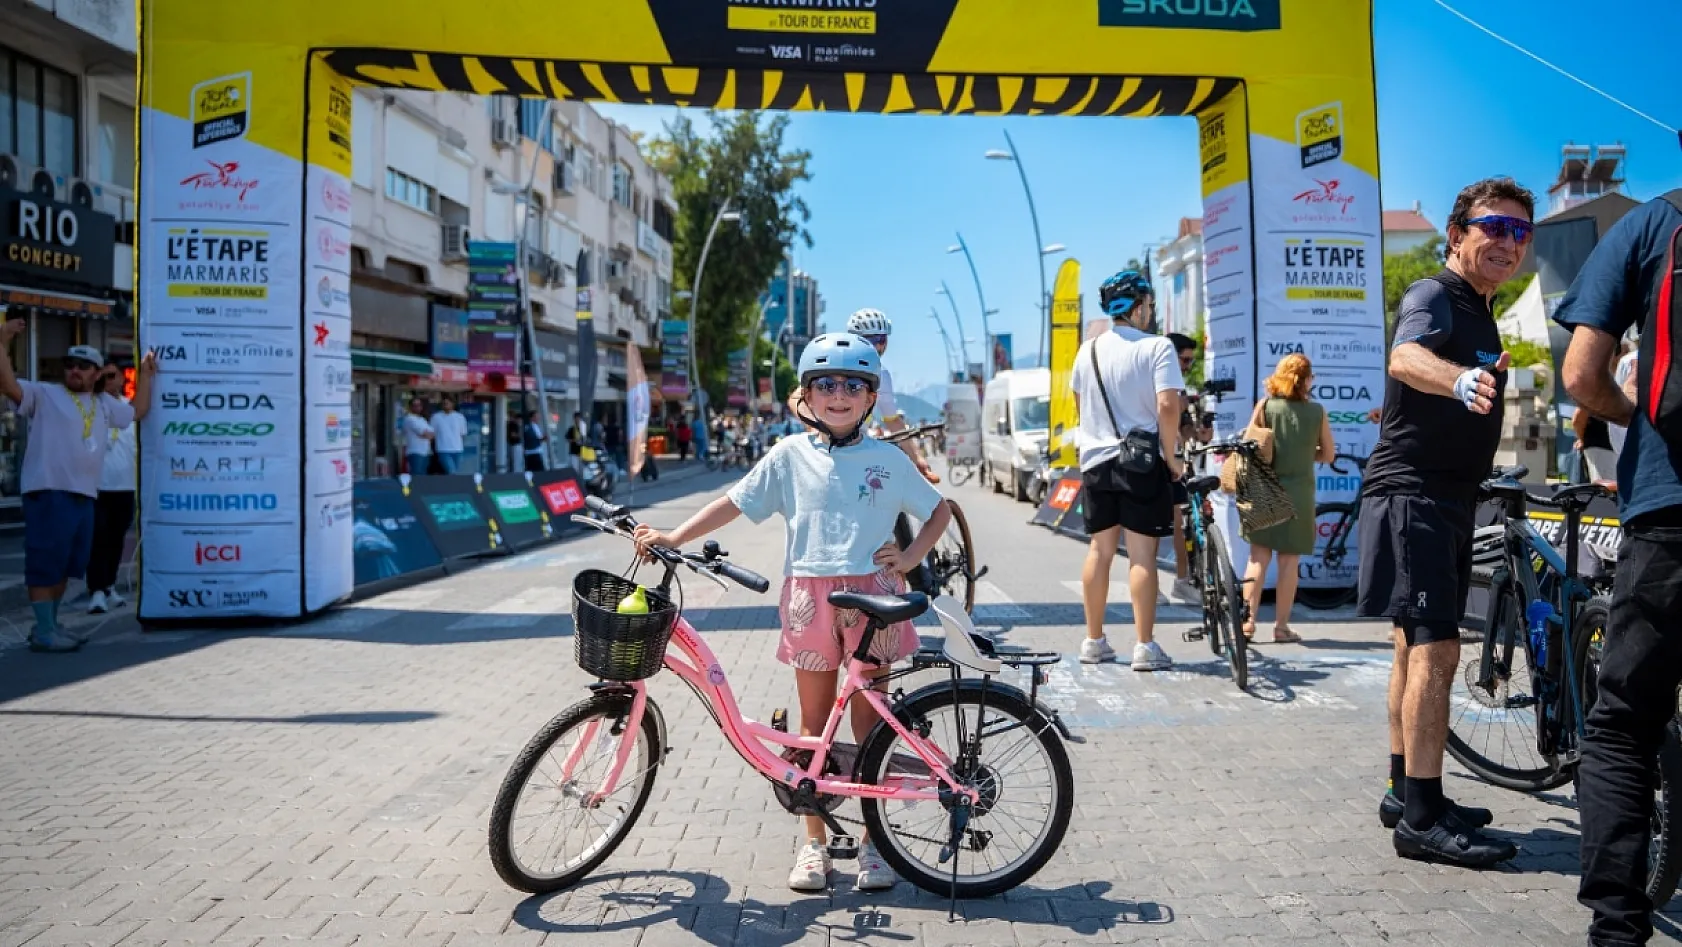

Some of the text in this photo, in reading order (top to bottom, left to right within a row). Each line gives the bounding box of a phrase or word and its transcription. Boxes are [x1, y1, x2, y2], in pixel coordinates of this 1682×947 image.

[778, 14, 809, 27] TOUR
[811, 16, 825, 28] DE
[828, 16, 870, 30] FRANCE
[771, 44, 802, 59] VISA
[19, 199, 78, 247] RIO
[9, 243, 82, 272] CONCEPT
[200, 287, 264, 298] TOUR DE FRANCE
[1314, 290, 1331, 298] TOUR
[1342, 290, 1364, 299] FRANCE
[195, 306, 216, 315] VISA
[150, 343, 294, 360] VISA maximiles
[1268, 342, 1304, 355] VISA
[1308, 385, 1371, 400] KODA
[163, 421, 275, 437] MOSSO
[170, 457, 265, 472] MARTI
[159, 493, 277, 510] SHIMANO
